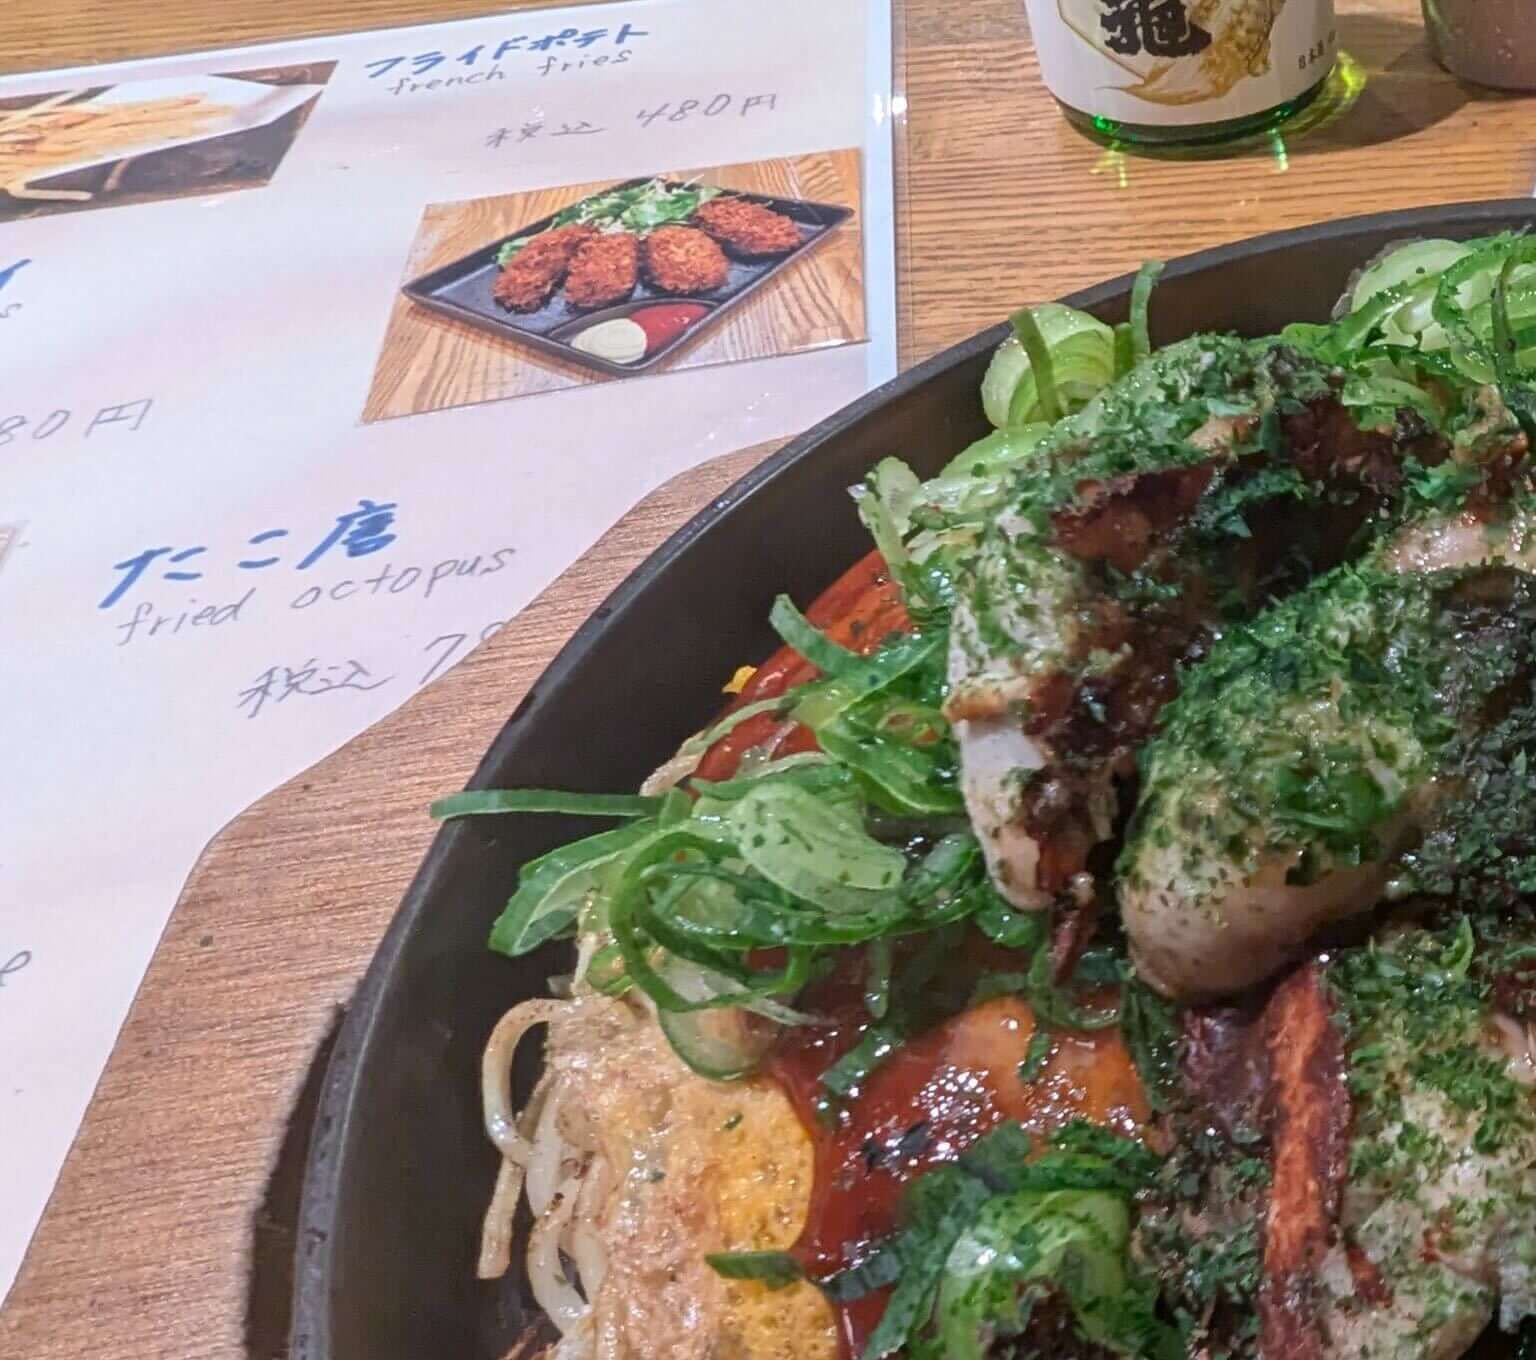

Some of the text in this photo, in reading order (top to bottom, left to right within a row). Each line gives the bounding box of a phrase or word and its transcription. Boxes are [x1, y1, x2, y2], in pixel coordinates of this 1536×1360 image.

[365, 23, 649, 78] フライドポテト
[387, 49, 632, 96] french fries
[117, 548, 516, 646] fried octopus
